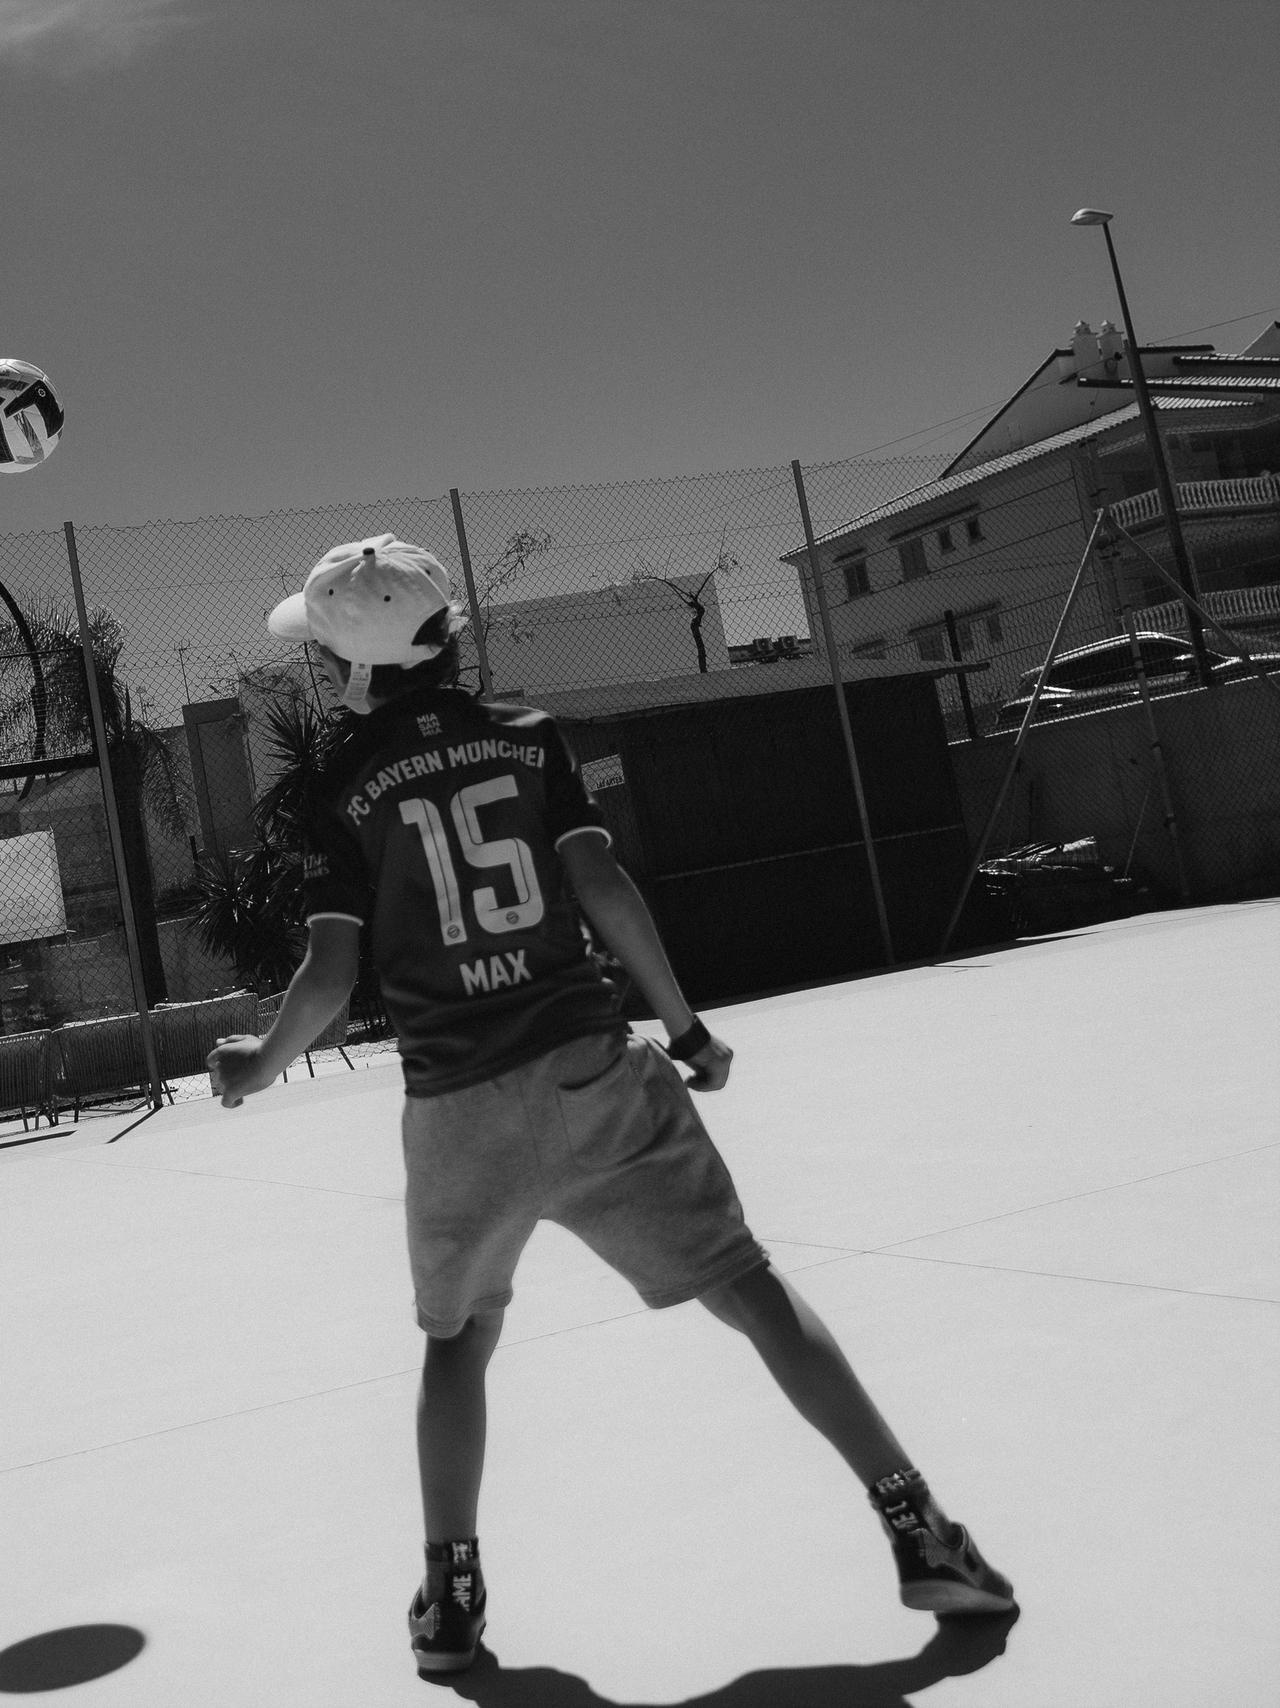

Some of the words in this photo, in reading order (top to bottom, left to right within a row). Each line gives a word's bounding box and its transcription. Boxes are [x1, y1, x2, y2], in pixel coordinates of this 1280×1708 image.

[416, 713, 438, 724] MIA
[365, 754, 444, 800] BAYERN
[398, 774, 544, 946] 15
[459, 950, 532, 995] MAX
